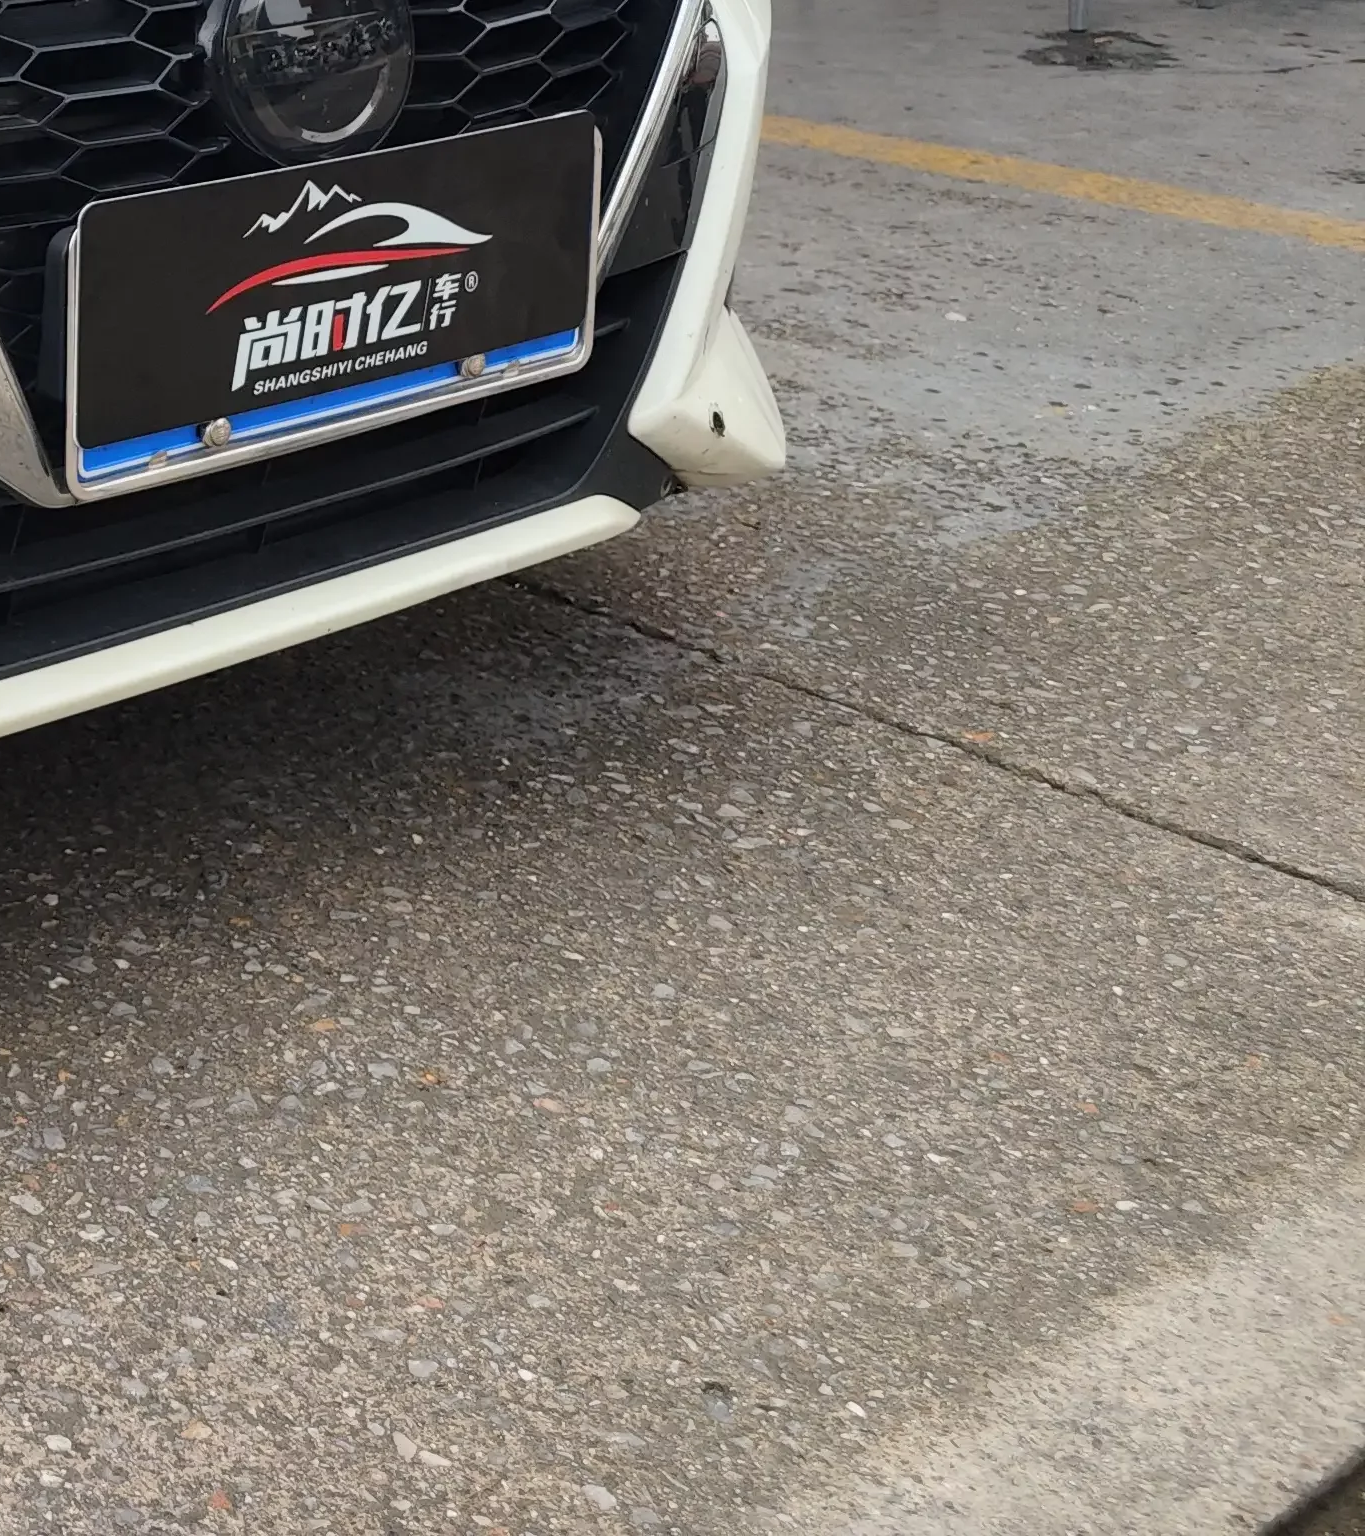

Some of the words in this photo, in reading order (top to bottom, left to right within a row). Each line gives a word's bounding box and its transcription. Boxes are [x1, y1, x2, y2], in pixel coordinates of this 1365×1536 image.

[429, 272, 462, 331] 车行
[231, 280, 422, 392] 尚时亿
[253, 359, 353, 396] SHANGSHIYI
[354, 340, 429, 371] CHEHANG
